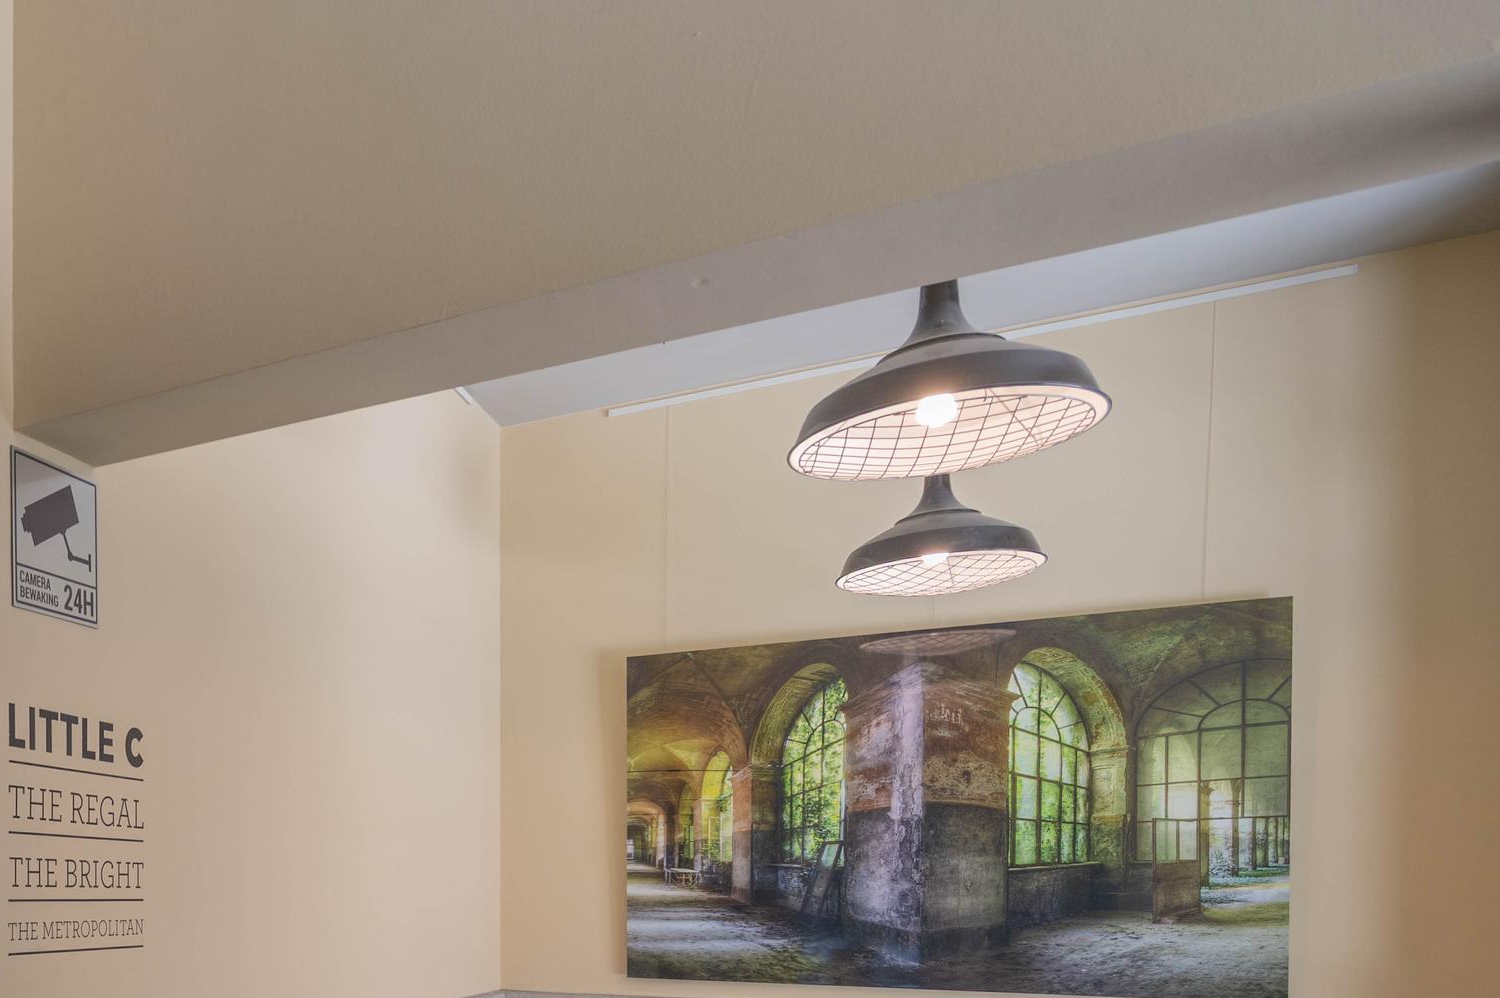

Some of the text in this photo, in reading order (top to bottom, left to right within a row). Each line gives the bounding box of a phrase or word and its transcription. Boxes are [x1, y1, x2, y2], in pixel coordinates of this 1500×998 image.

[19, 570, 52, 591] CAMERA
[19, 585, 59, 608] BEWAKING
[63, 584, 94, 617] 24H
[8, 702, 144, 768] LITTLE C
[8, 784, 144, 829] THE REGAL
[9, 857, 144, 888] THE BRIGHT
[7, 918, 144, 941] THE METROPOLITAN
